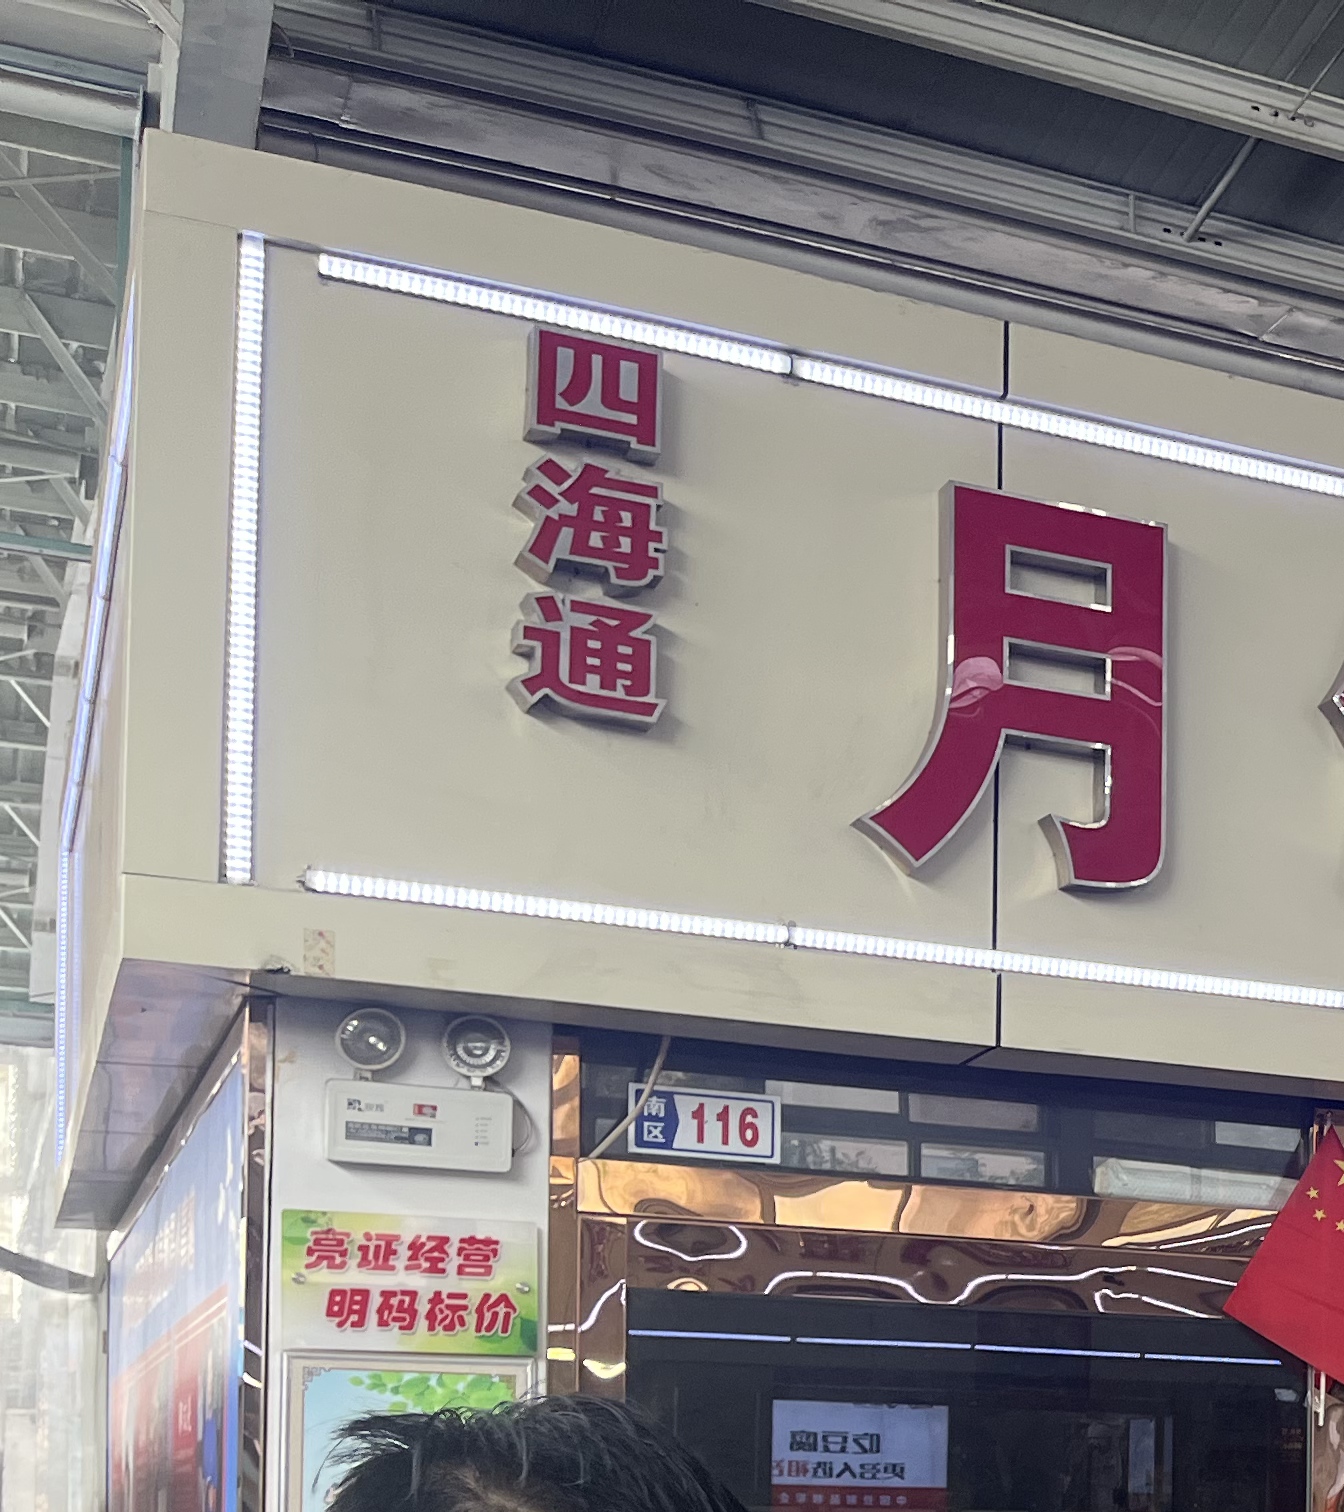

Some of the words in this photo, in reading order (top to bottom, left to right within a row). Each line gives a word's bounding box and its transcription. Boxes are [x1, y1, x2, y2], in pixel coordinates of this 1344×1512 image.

[516, 326, 667, 731] 四海通
[640, 1096, 667, 1144] 南区
[688, 1101, 760, 1150] 116
[304, 1228, 502, 1278] 亮证经营
[325, 1287, 522, 1337] 明码标价
